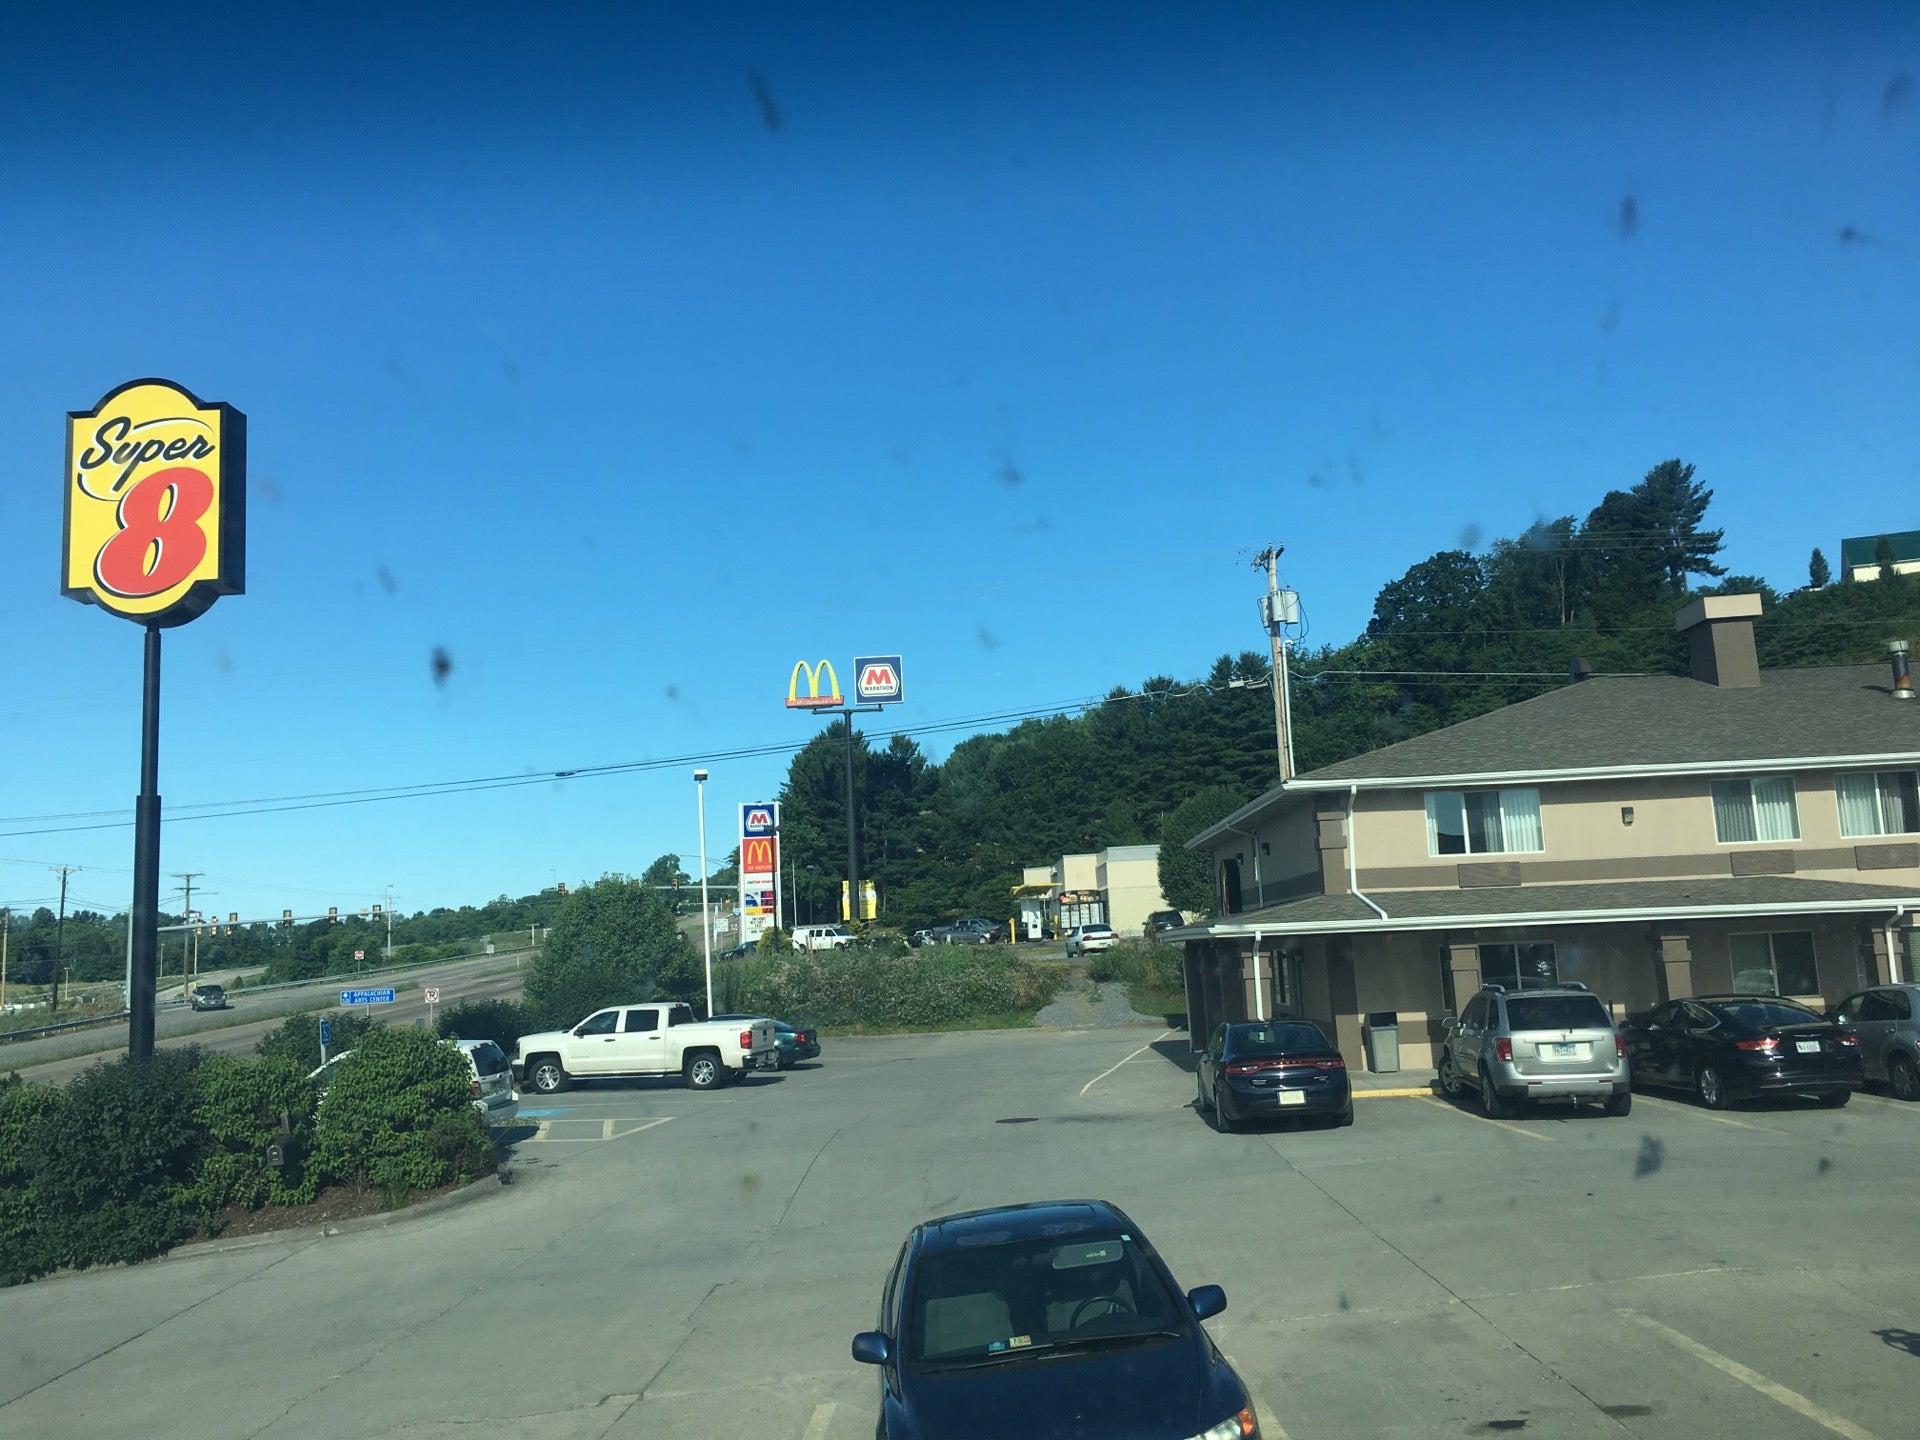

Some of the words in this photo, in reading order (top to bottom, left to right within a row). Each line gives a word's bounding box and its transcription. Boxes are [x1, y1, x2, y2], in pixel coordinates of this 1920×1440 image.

[79, 416, 216, 493] Super
[93, 466, 214, 599] 8
[866, 668, 892, 685] M
[353, 989, 391, 997] APPALACHIAN
[369, 995, 390, 1003] CENTER
